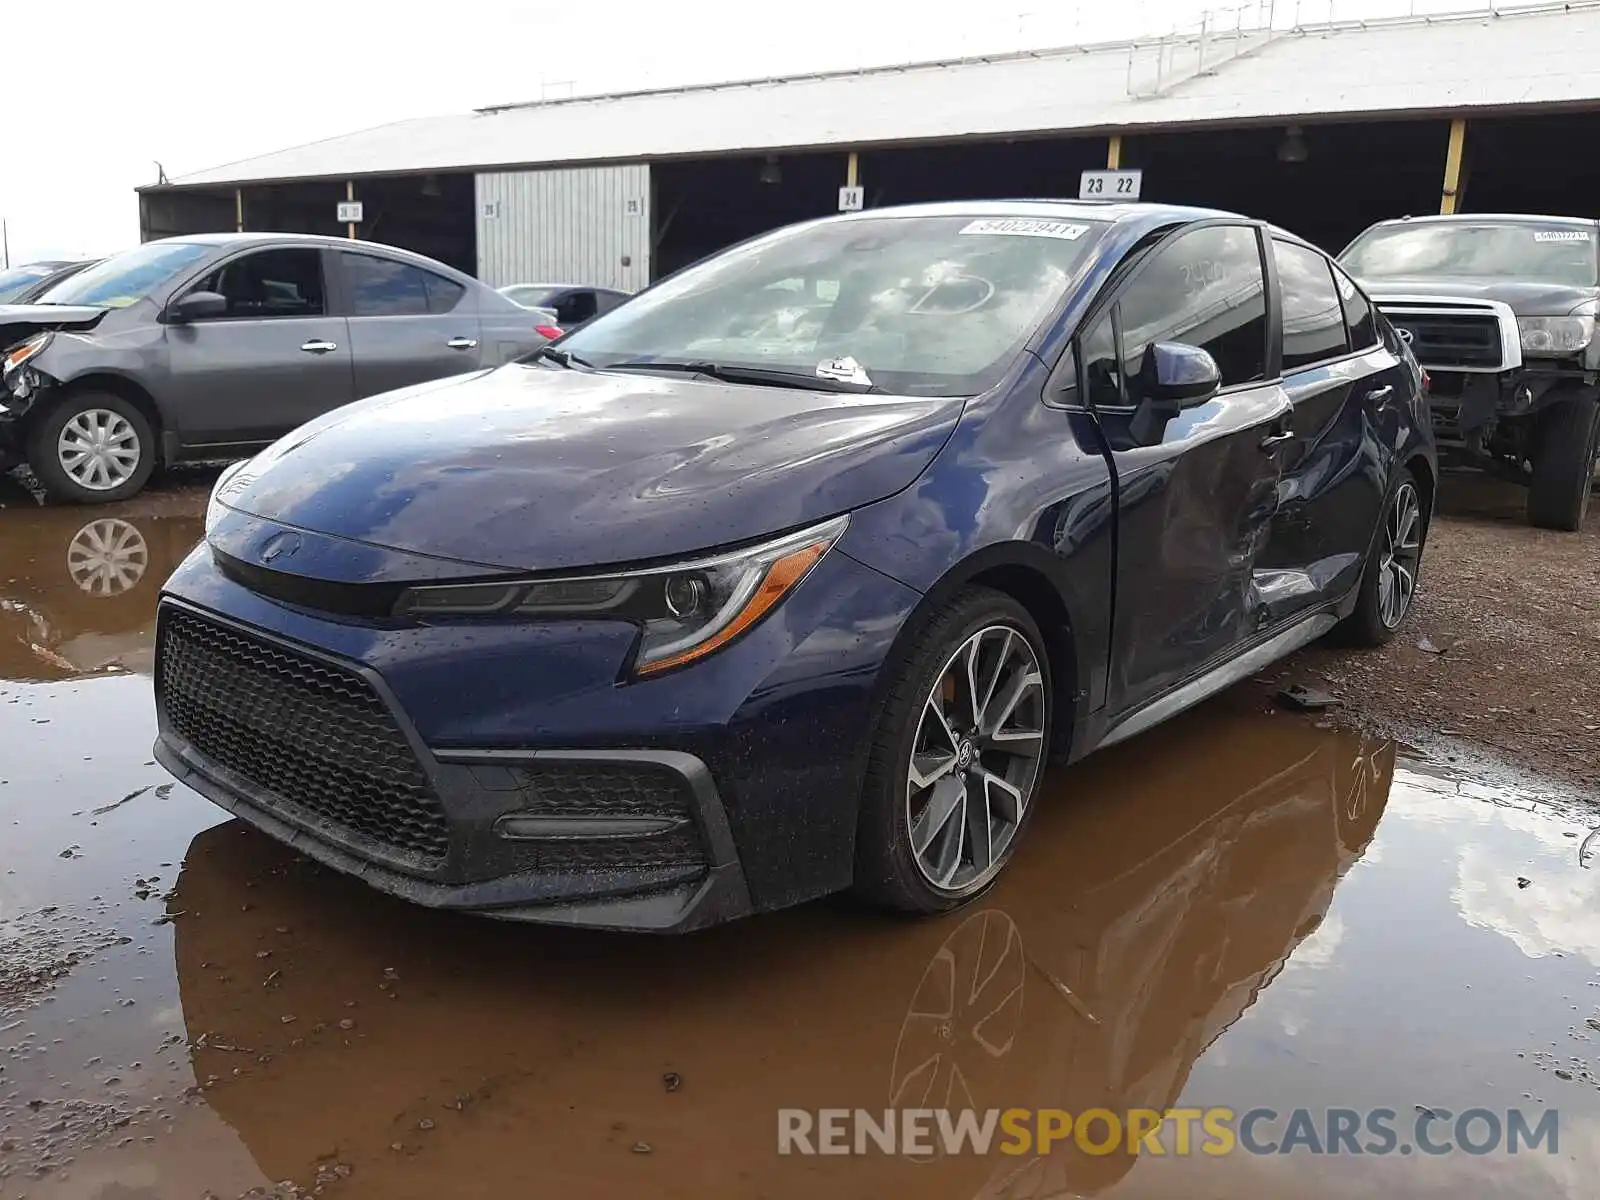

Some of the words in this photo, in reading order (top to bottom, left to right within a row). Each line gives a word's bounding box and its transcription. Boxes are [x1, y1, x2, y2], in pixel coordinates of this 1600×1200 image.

[1087, 178, 1103, 193] 23
[1117, 178, 1133, 193] 22
[844, 192, 857, 206] 24
